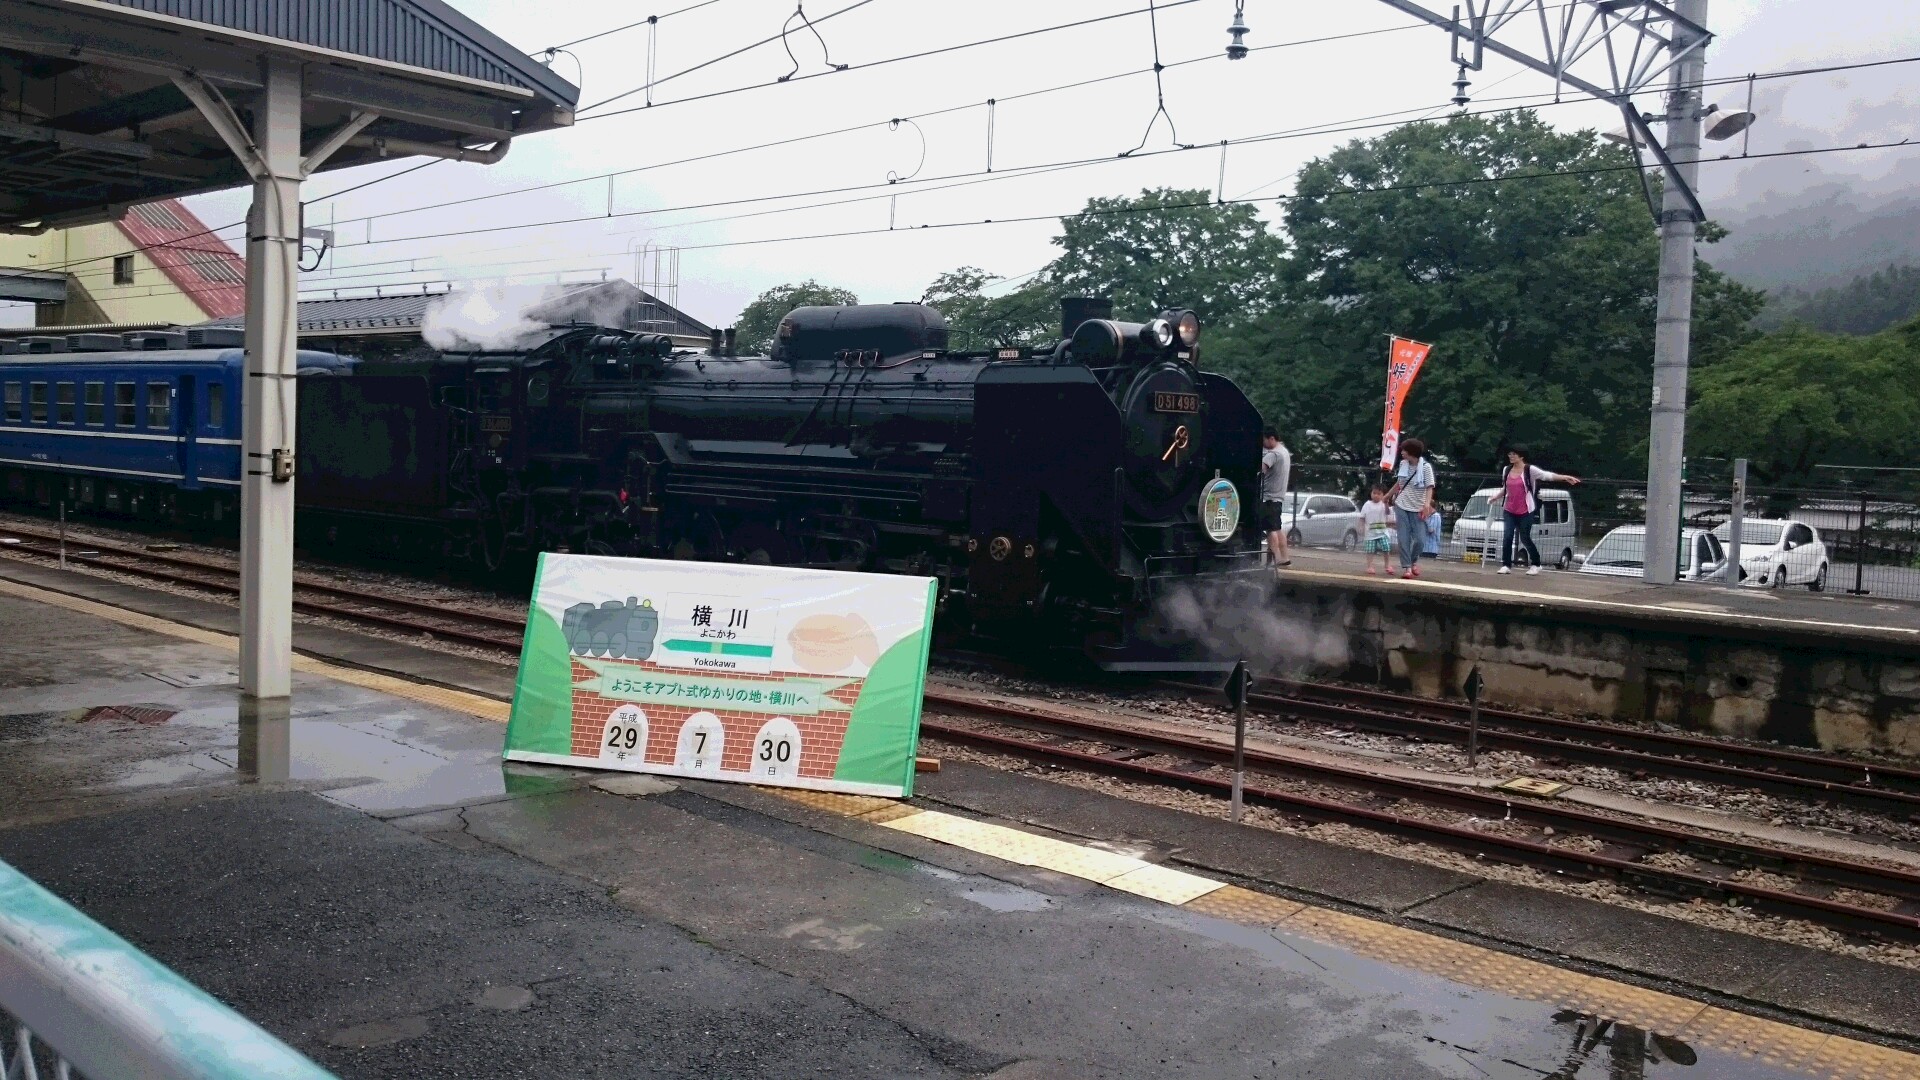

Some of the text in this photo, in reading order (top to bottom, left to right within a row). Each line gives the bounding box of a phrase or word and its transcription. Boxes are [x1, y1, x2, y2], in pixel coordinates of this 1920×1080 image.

[1177, 395, 1196, 411] 498
[691, 604, 749, 629] 横川
[700, 629, 736, 640] よこかわ
[693, 657, 736, 668] Yokokawa
[611, 678, 810, 706] ようこそアプト式ゆかりの地・横川へ
[618, 712, 638, 723] 平成
[607, 725, 638, 750] 29
[694, 732, 707, 755] 7
[616, 752, 626, 761] 年
[759, 739, 791, 762] 30
[694, 760, 703, 769] 月
[767, 766, 776, 776] 日
